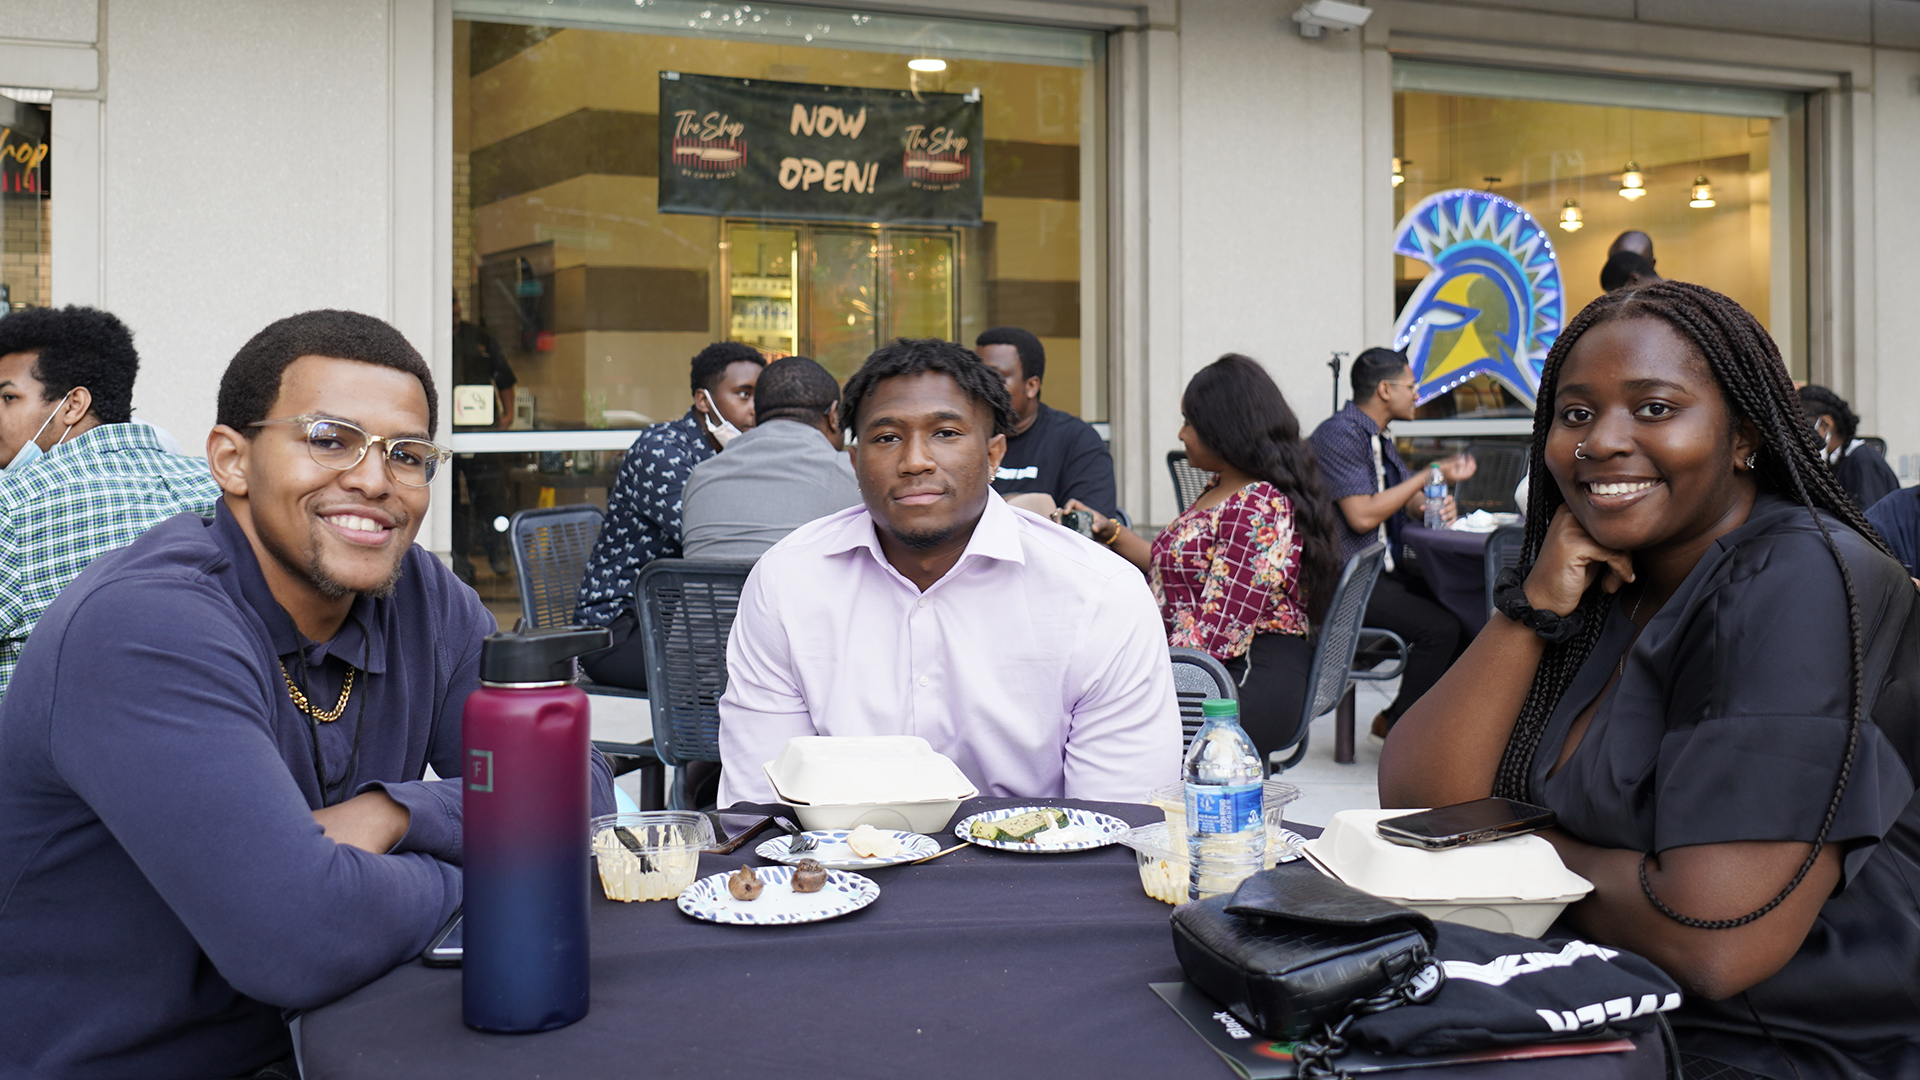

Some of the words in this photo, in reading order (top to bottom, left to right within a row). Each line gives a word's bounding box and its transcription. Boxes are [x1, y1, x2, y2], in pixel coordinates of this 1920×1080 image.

[674, 110, 700, 139] The
[700, 111, 744, 147] Shop
[790, 103, 867, 140] NOW
[905, 125, 929, 154] The
[927, 126, 968, 160] Shop
[778, 156, 880, 194] OPEN!
[1212, 1011, 1252, 1039] Black
